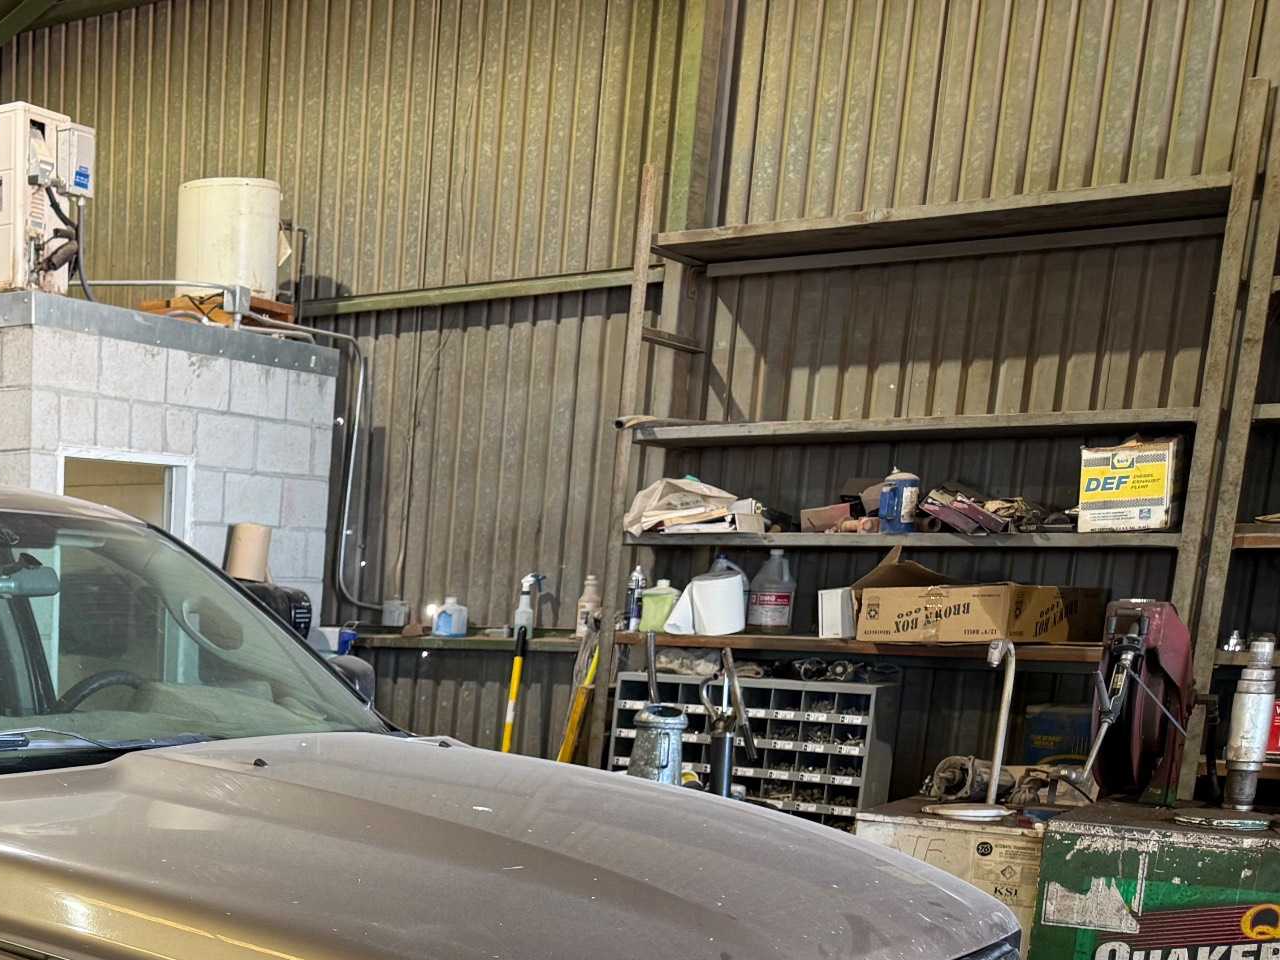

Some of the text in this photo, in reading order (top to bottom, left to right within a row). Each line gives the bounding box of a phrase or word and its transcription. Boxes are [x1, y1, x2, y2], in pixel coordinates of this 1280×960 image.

[1085, 475, 1130, 492] DEF
[894, 602, 970, 634] BROWN BOX
[897, 606, 929, 619] 1000
[977, 843, 992, 855] 76
[1240, 903, 1280, 940] Q
